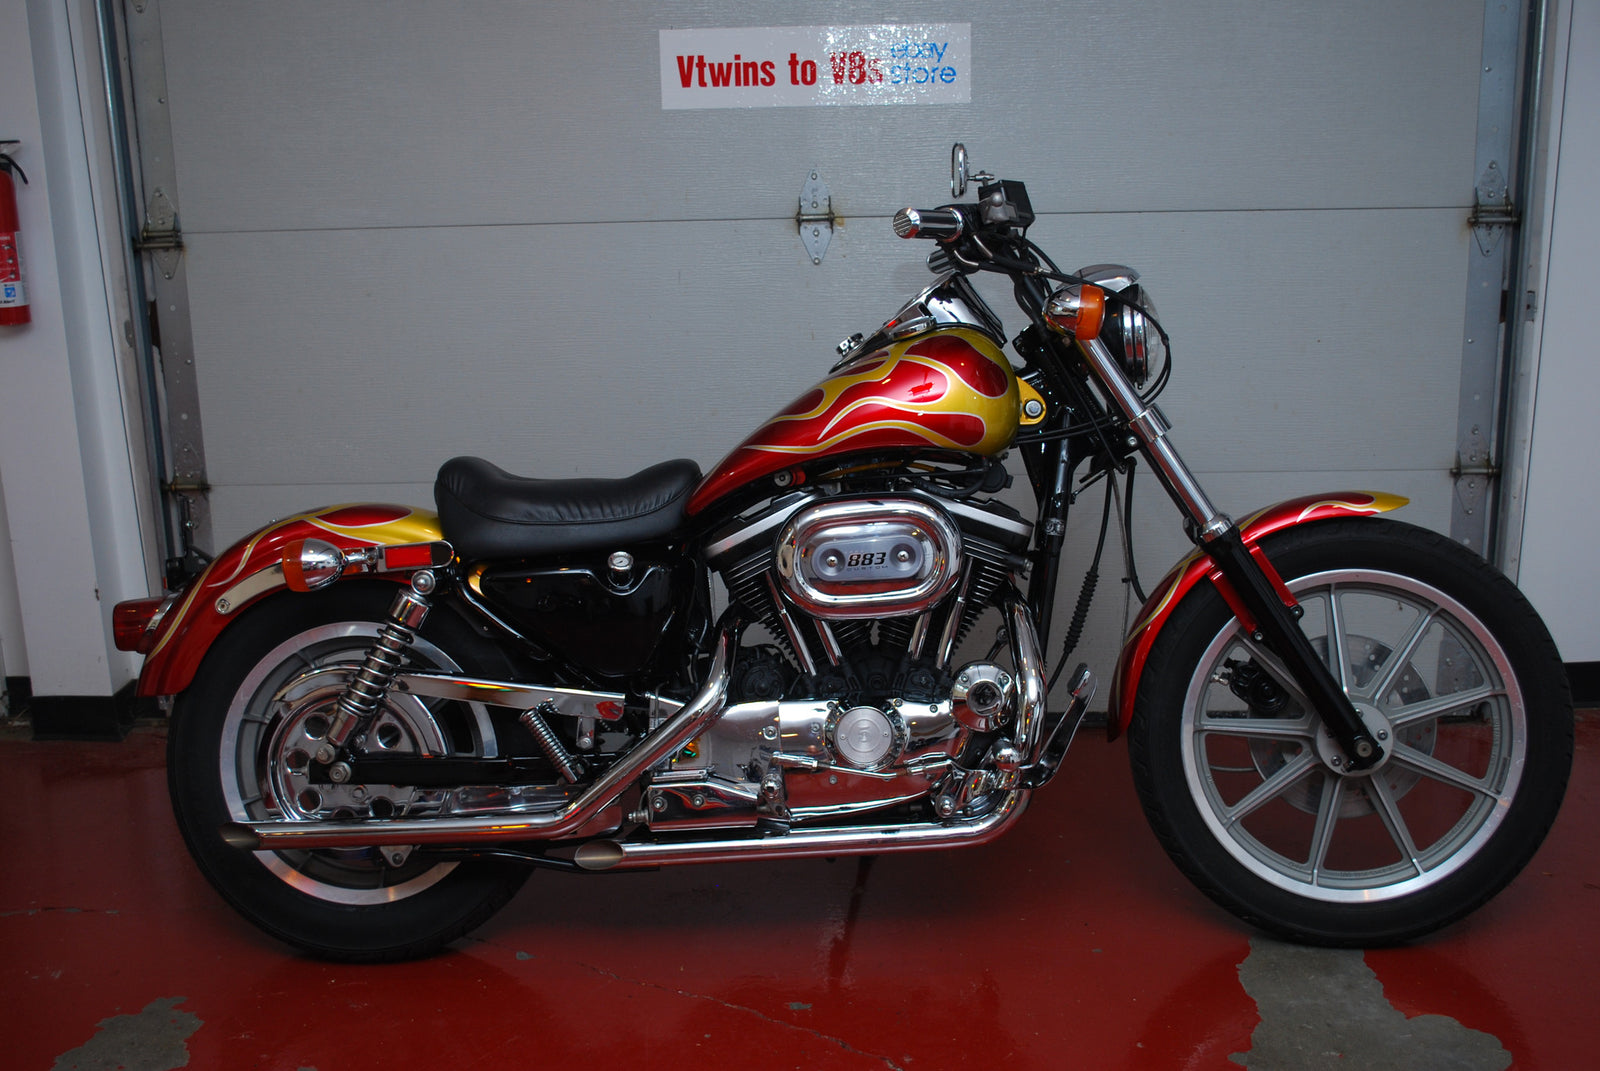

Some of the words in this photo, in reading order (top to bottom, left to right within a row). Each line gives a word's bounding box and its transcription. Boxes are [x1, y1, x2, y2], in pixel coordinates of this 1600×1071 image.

[890, 36, 949, 63] ebay
[676, 54, 776, 88] Vtwins
[787, 53, 817, 86] to
[829, 50, 884, 85] V8s
[890, 62, 957, 84] store
[847, 552, 887, 567] 883
